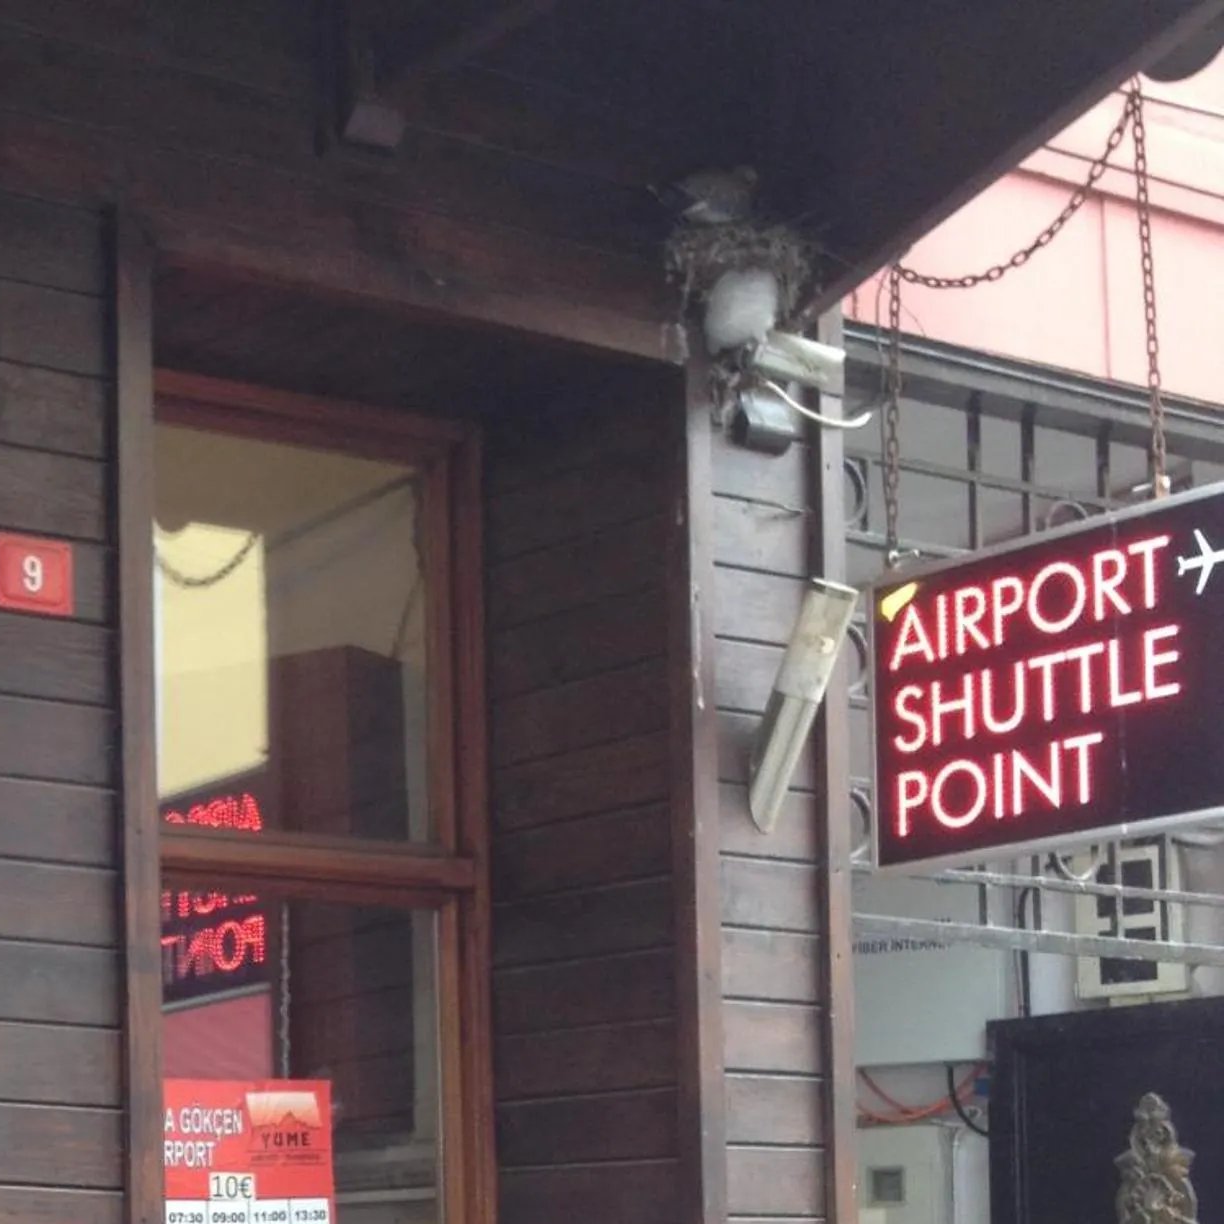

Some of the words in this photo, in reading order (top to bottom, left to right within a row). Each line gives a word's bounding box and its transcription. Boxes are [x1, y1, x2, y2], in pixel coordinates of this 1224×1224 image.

[22, 554, 44, 593] 9
[888, 534, 1172, 673] AIRPORT
[893, 624, 1181, 754] SHUTTLE
[897, 731, 1104, 838] POINT
[164, 1140, 216, 1168] RPORT
[212, 1175, 253, 1199] 10€
[169, 1211, 204, 1224] 07:30
[212, 1211, 246, 1224] 09:00
[253, 1210, 287, 1223] 11:00
[295, 1209, 327, 1222] 13:30
